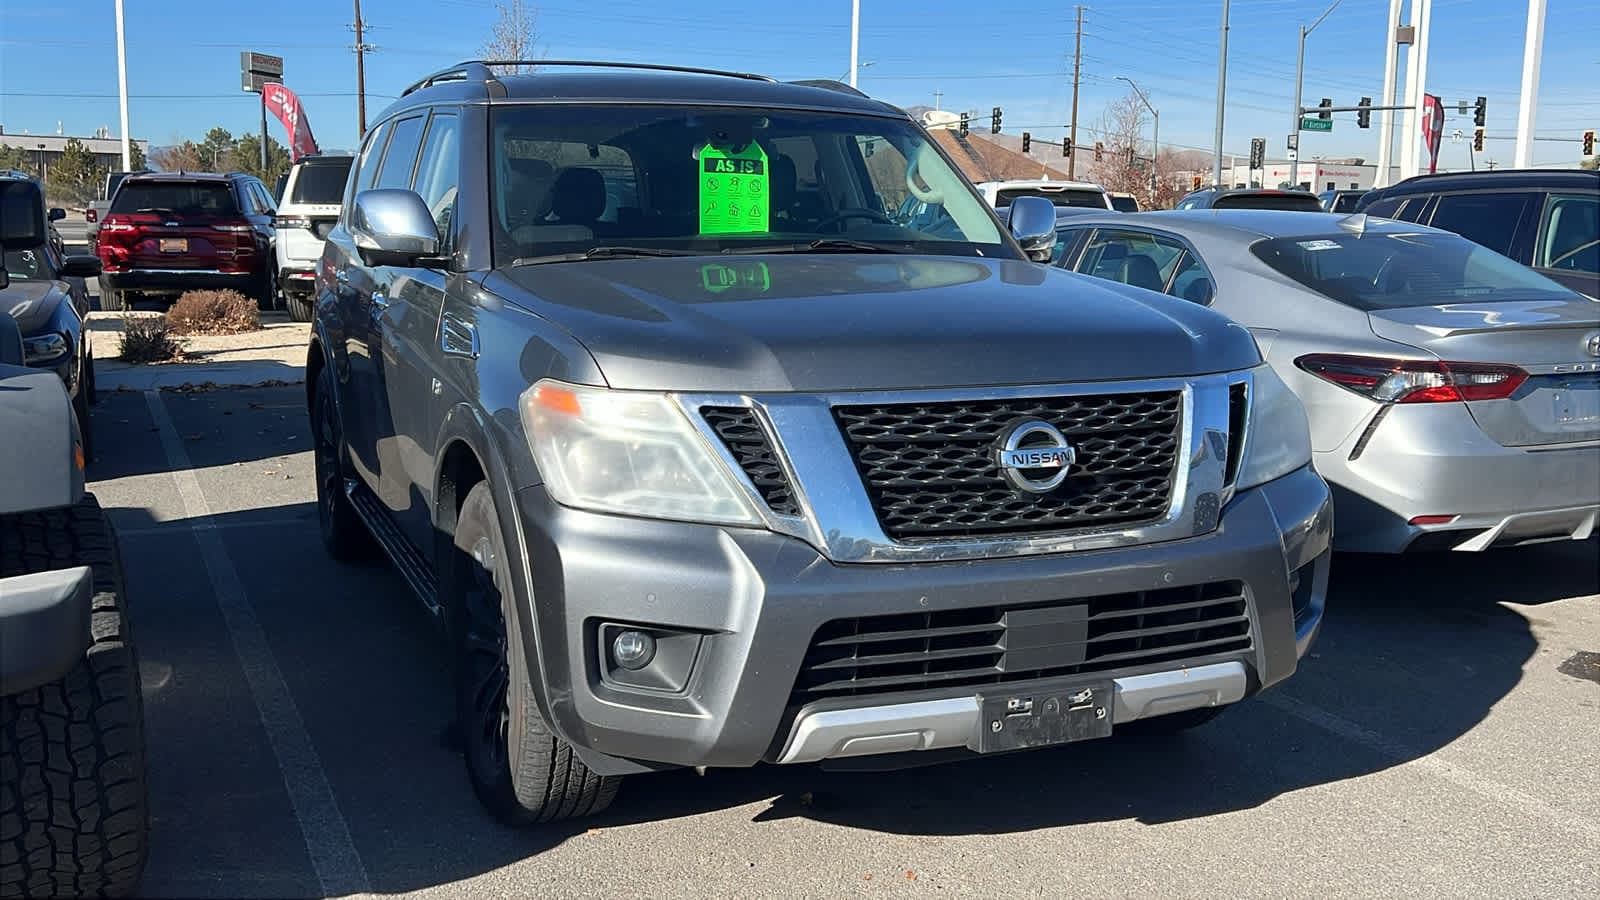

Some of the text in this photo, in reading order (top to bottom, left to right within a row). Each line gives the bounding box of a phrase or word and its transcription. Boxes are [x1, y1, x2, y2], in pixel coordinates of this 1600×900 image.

[715, 160, 754, 173] AS IS
[1012, 450, 1071, 465] NISSAN
